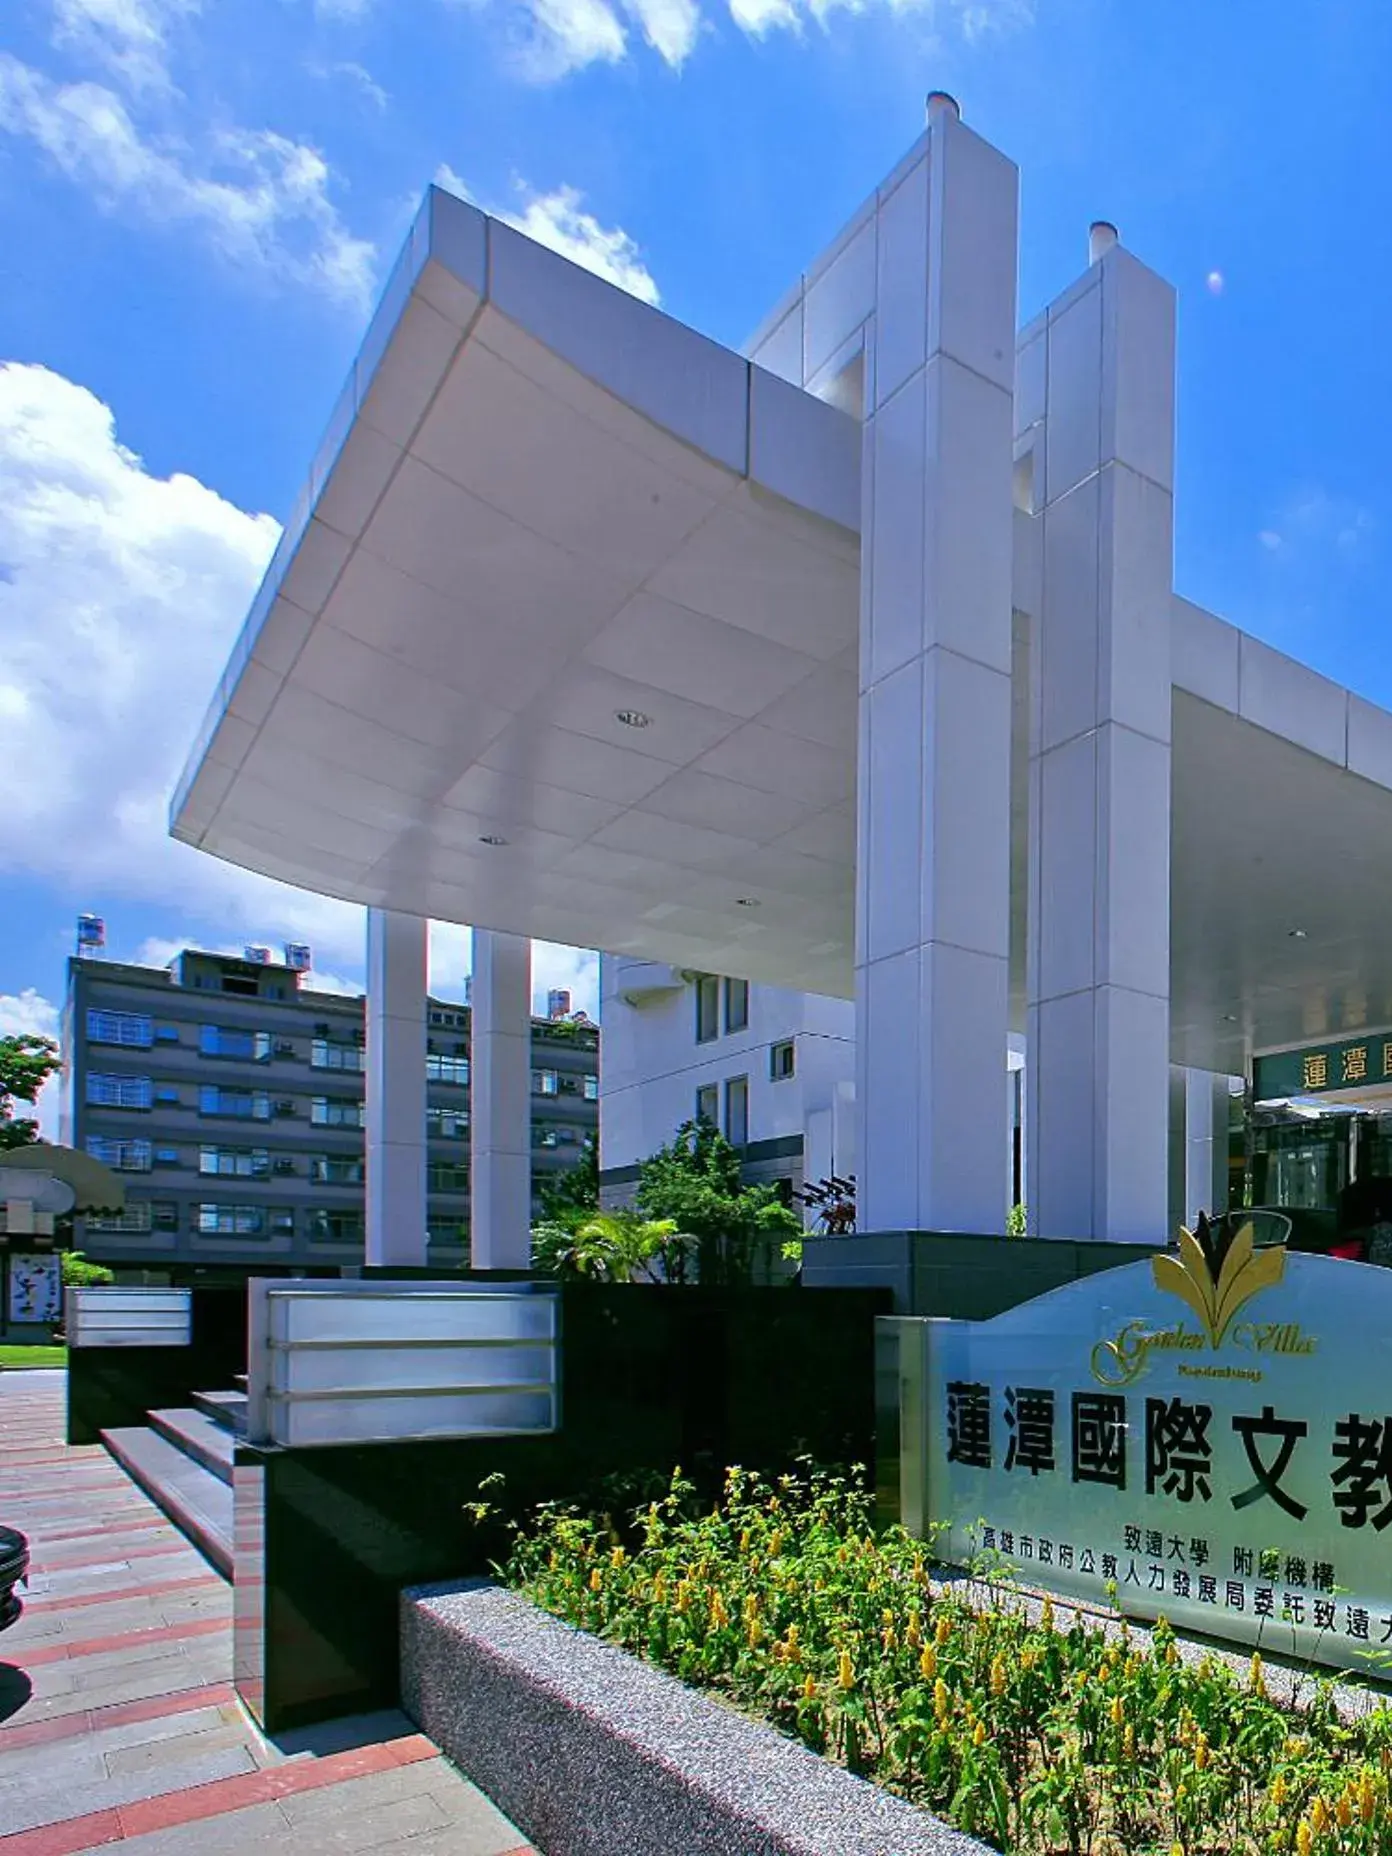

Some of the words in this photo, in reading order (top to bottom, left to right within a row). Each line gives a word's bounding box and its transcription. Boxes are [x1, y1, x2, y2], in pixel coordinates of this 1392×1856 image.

[1091, 1321, 1205, 1386] Garden
[1233, 1323, 1317, 1354] Villa
[1124, 1525, 1209, 1568] 致遠大學
